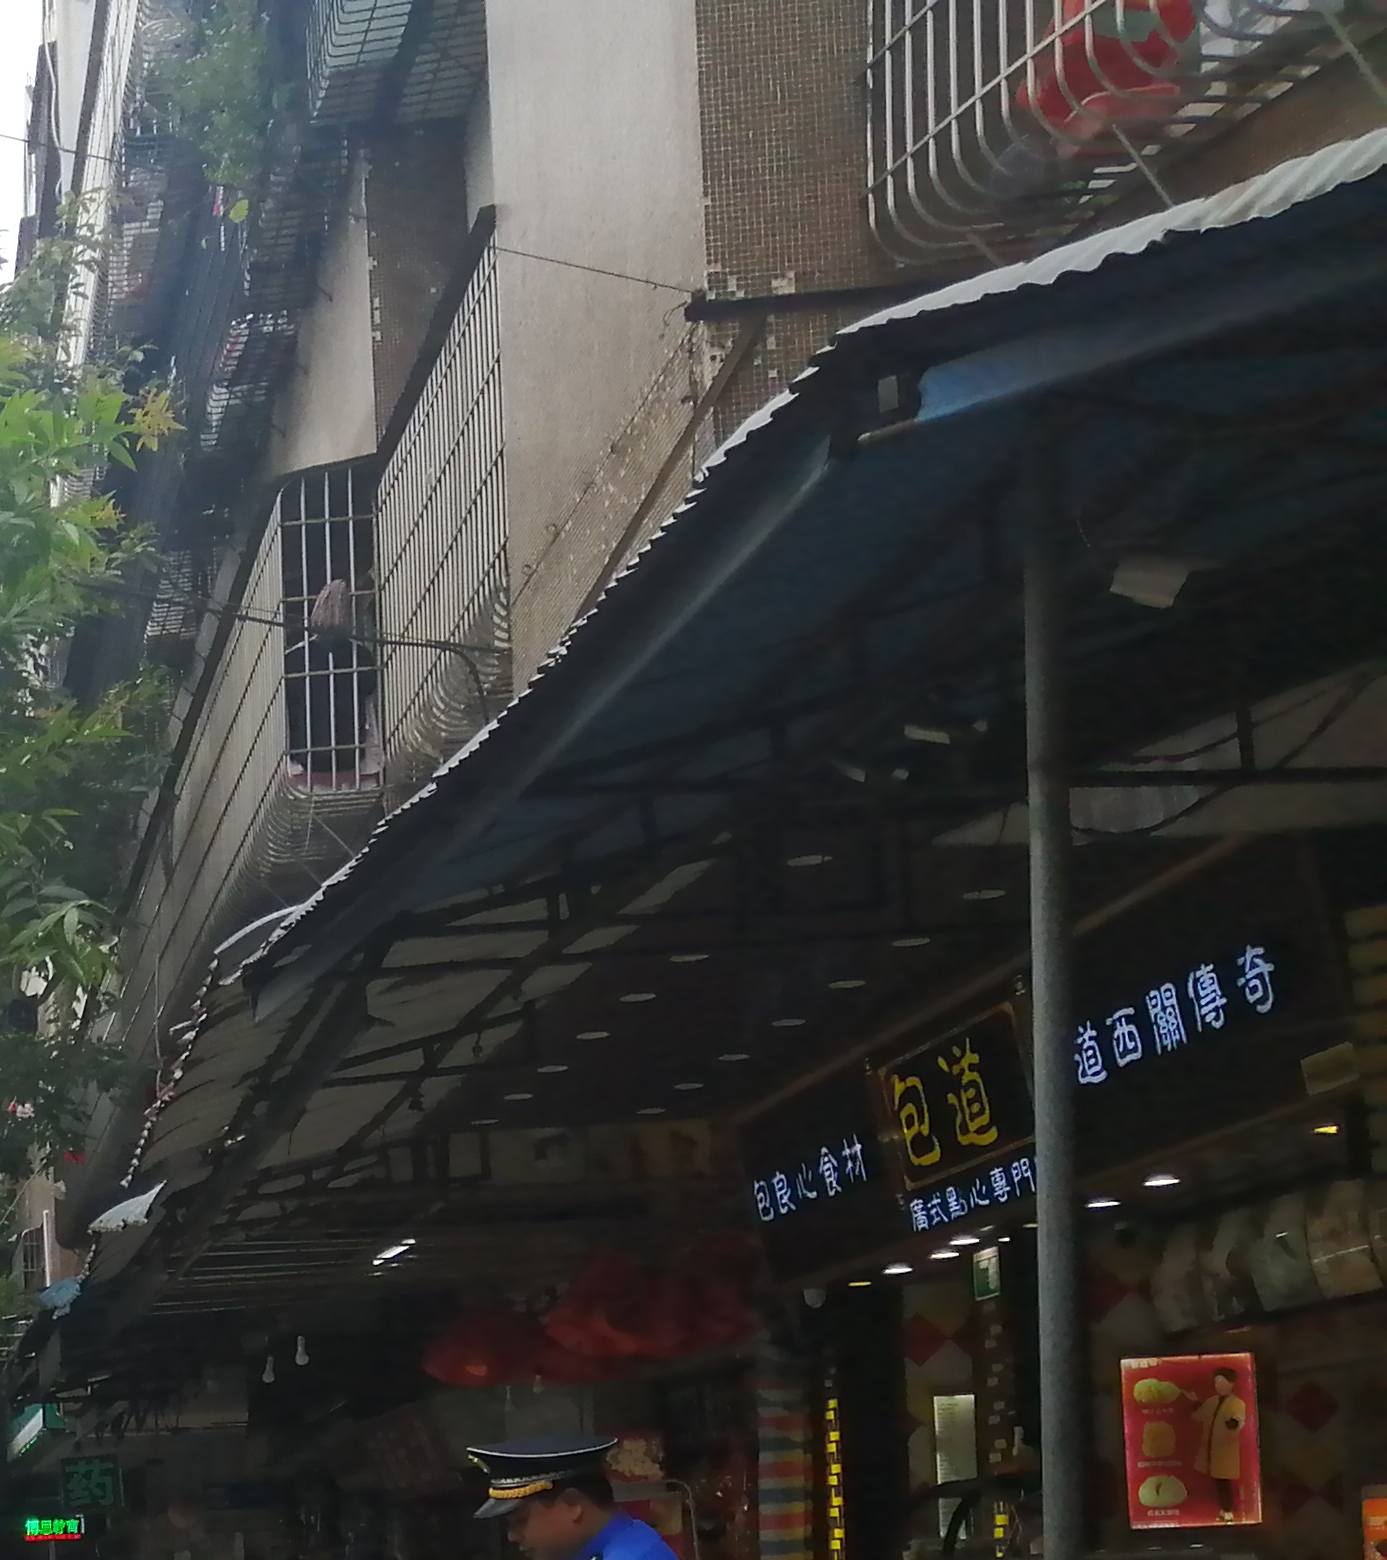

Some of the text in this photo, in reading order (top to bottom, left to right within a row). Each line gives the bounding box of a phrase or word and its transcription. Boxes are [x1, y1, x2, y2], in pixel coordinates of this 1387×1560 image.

[1073, 944, 1276, 1086] 道西關傳奇
[892, 1037, 999, 1166] 包道
[753, 1134, 868, 1222] 包良心食材
[909, 1157, 1036, 1232] 廣式點心專門
[64, 1460, 114, 1507] 药
